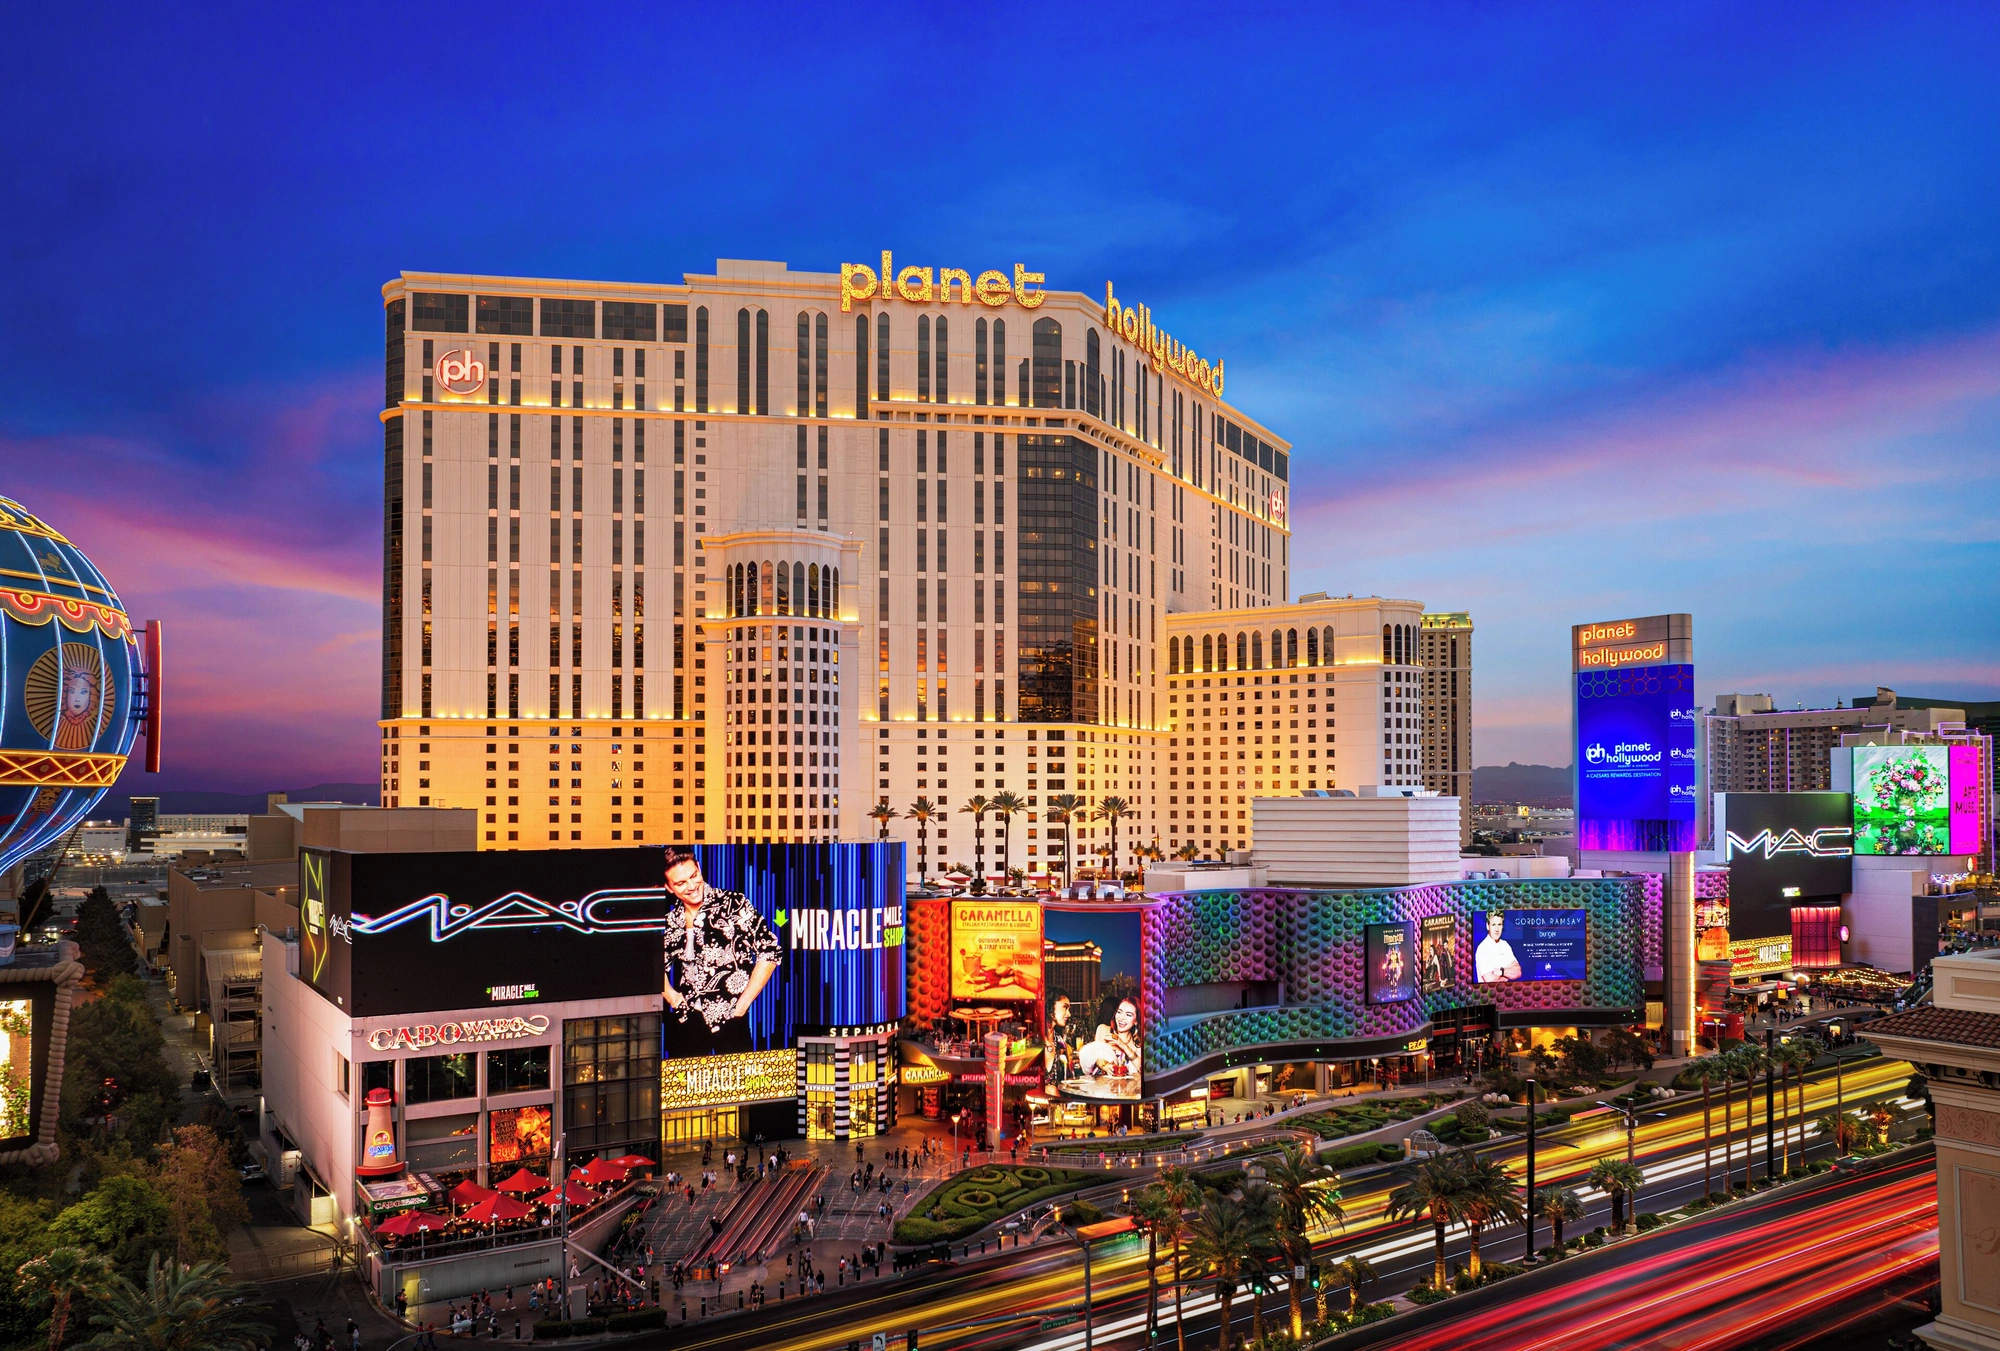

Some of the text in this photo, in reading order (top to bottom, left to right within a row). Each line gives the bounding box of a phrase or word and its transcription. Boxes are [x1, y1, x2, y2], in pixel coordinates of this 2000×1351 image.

[840, 250, 1046, 313] planet
[1106, 280, 1224, 398] hollywood
[441, 350, 485, 387] ph
[1582, 622, 1635, 646] planet
[1582, 643, 1664, 667] hollywood
[1588, 743, 1606, 758] ph
[1615, 742, 1651, 754] planet
[1606, 751, 1662, 764] hollywood
[884, 906, 902, 926] MILE
[960, 910, 1033, 922] CARAMELLA
[1424, 916, 1454, 927] CARAMELLA
[1514, 918, 1546, 926] GORDON
[791, 908, 883, 950] MIRACLE
[884, 926, 906, 948] SHOPS
[492, 985, 524, 1000] MIRACLE
[367, 1014, 549, 1051] CABO WABO
[467, 1032, 523, 1043] CANTINA
[829, 1022, 899, 1038] SEPHORA
[686, 1065, 743, 1095] MIRACLE
[851, 1082, 878, 1091] SEPHORA
